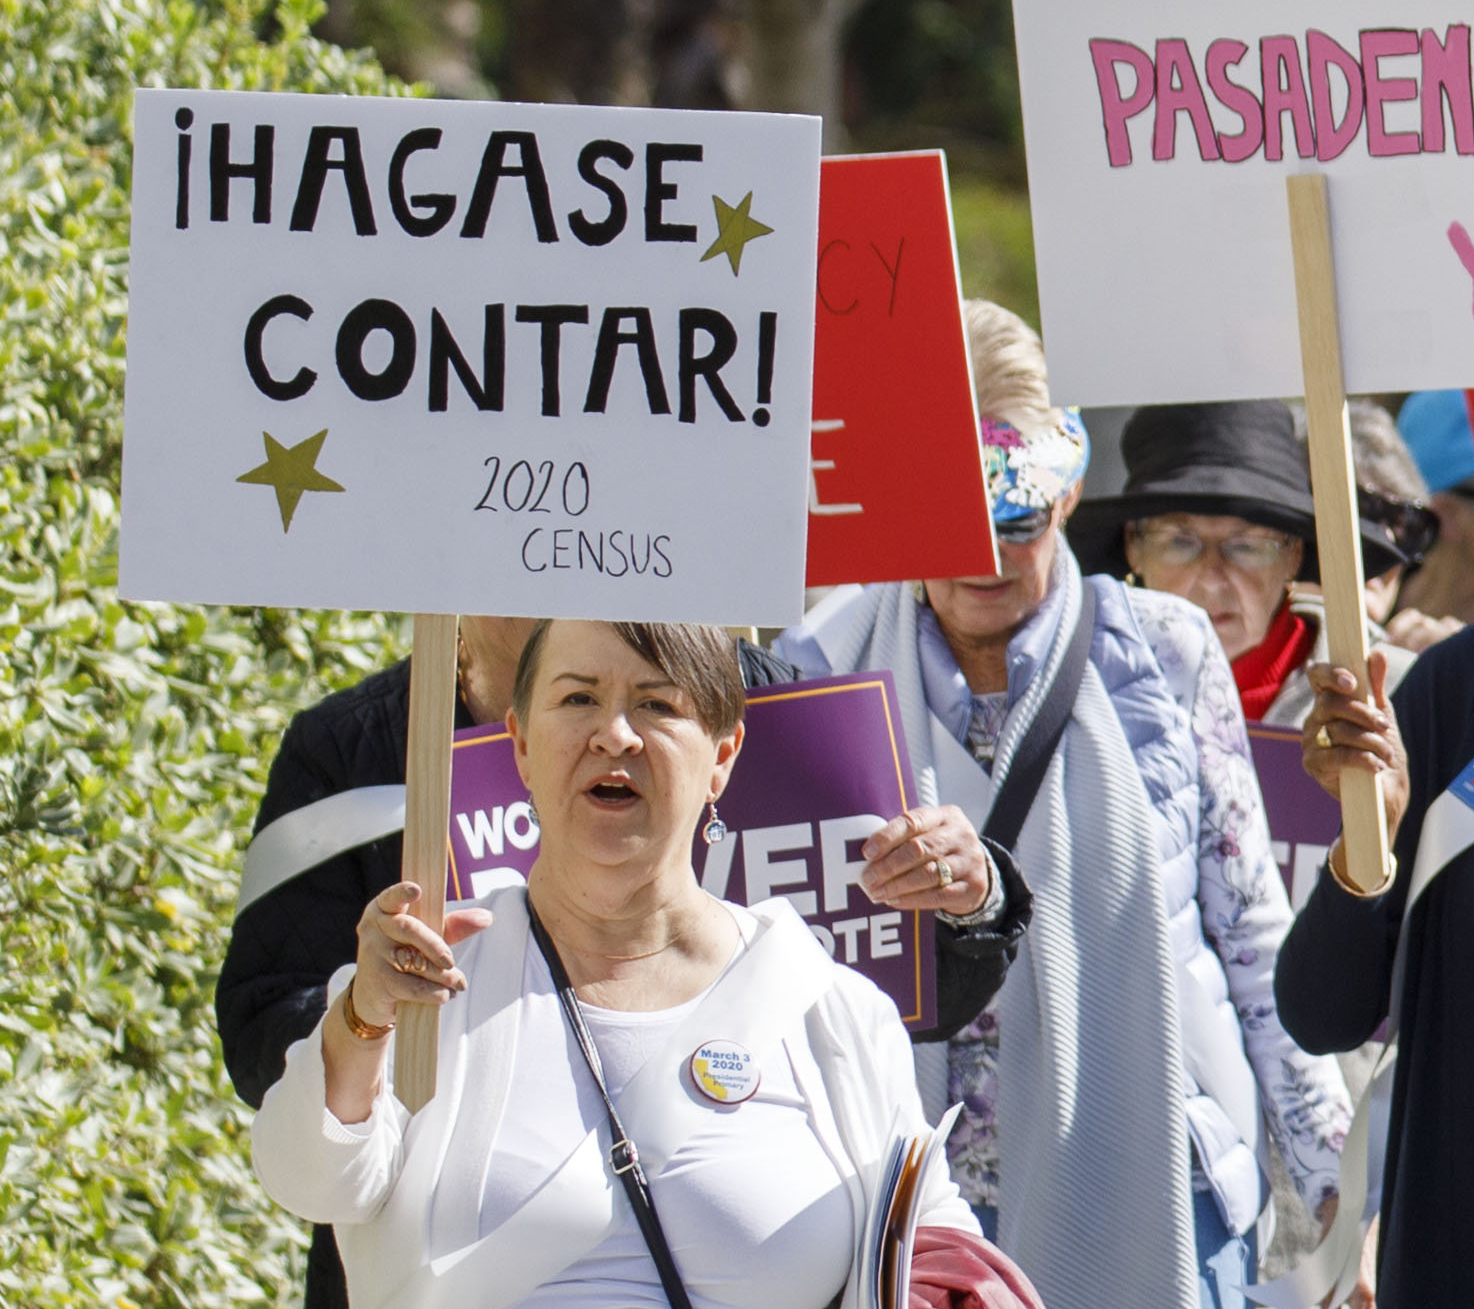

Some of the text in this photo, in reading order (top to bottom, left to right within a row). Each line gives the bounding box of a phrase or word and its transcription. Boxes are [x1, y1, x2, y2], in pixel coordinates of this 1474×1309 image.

[173, 106, 706, 247] ¡HAGASE
[243, 293, 778, 429] CONTAR!
[475, 456, 591, 518] 2020
[520, 528, 674, 579] CENSUS
[700, 1049, 750, 1062] March 3
[712, 1059, 744, 1071] 2020
